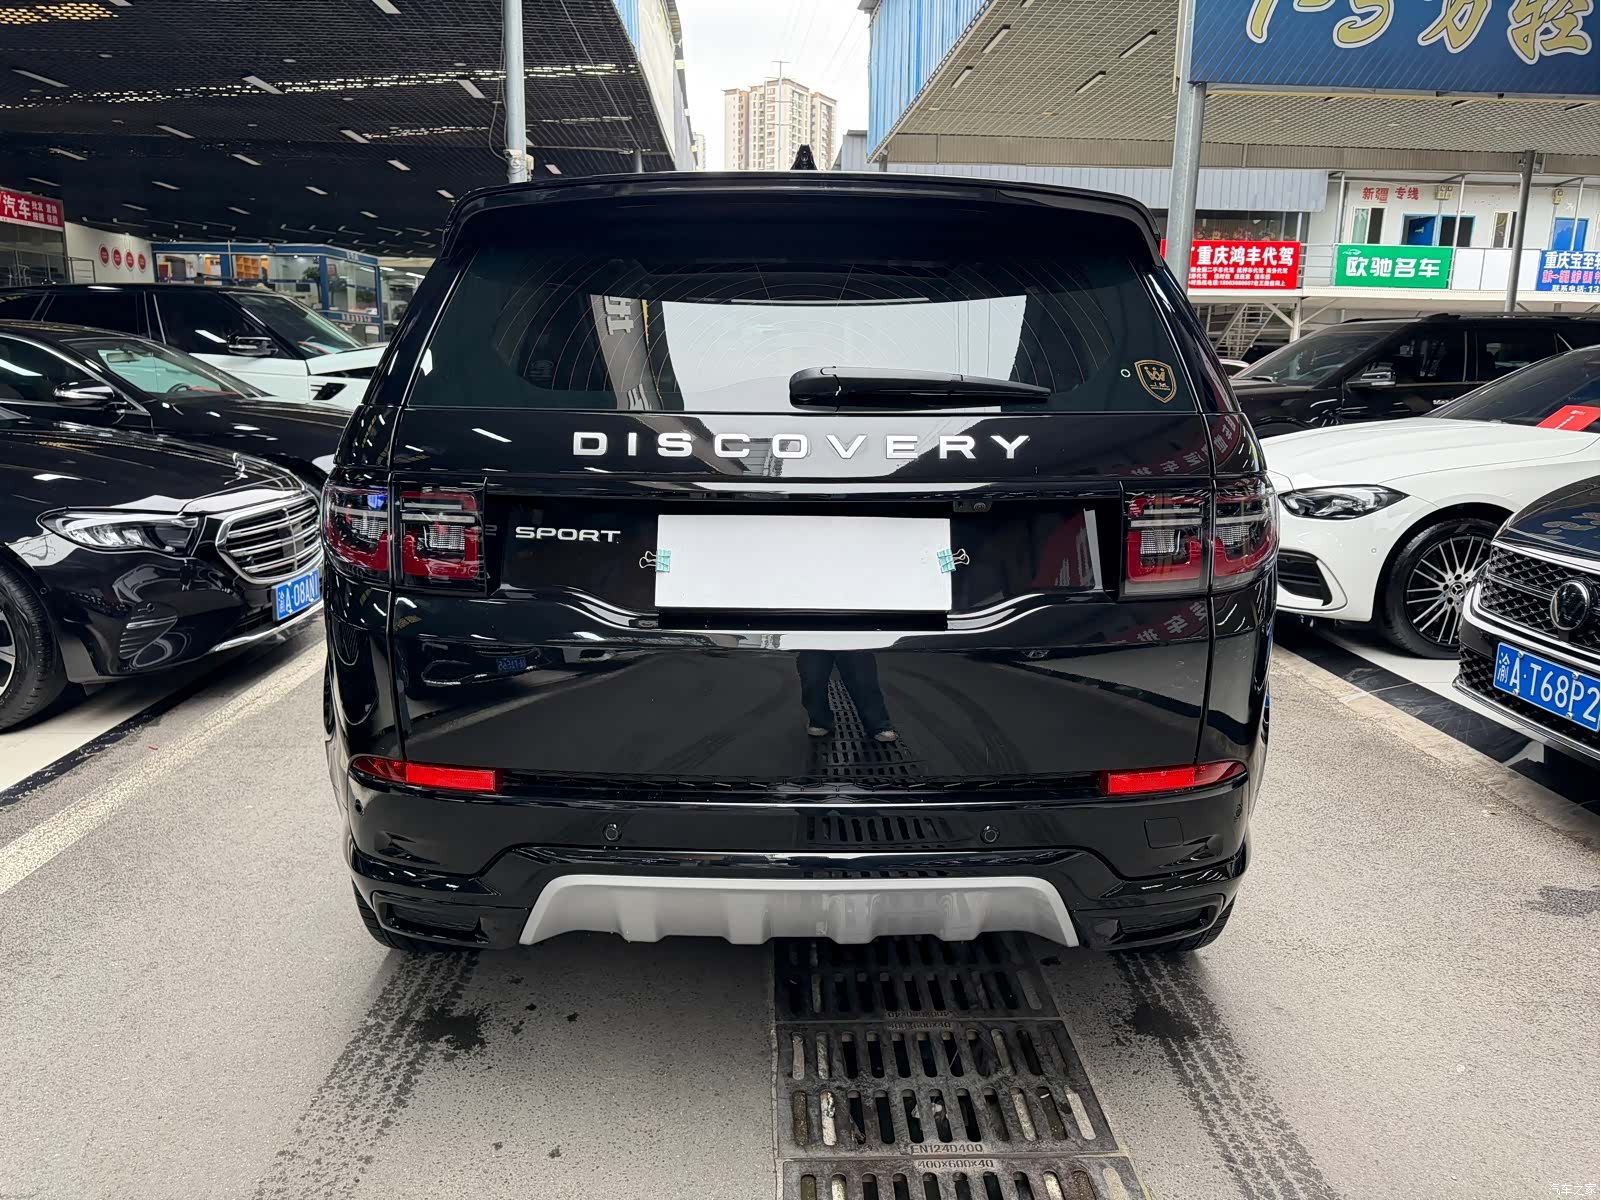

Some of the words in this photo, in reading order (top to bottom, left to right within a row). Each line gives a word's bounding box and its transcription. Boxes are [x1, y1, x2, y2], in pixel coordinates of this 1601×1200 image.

[1362, 186, 1389, 203] 新疆
[1395, 187, 1419, 200] 专线
[3, 194, 31, 220] 汽车
[1197, 245, 1294, 266] 重庆鸿丰代驾
[1345, 256, 1441, 278] 欧驰名车
[572, 431, 1030, 459] DISCOVERY
[515, 526, 622, 543] SPORT
[911, 1143, 984, 1155] EN124D400
